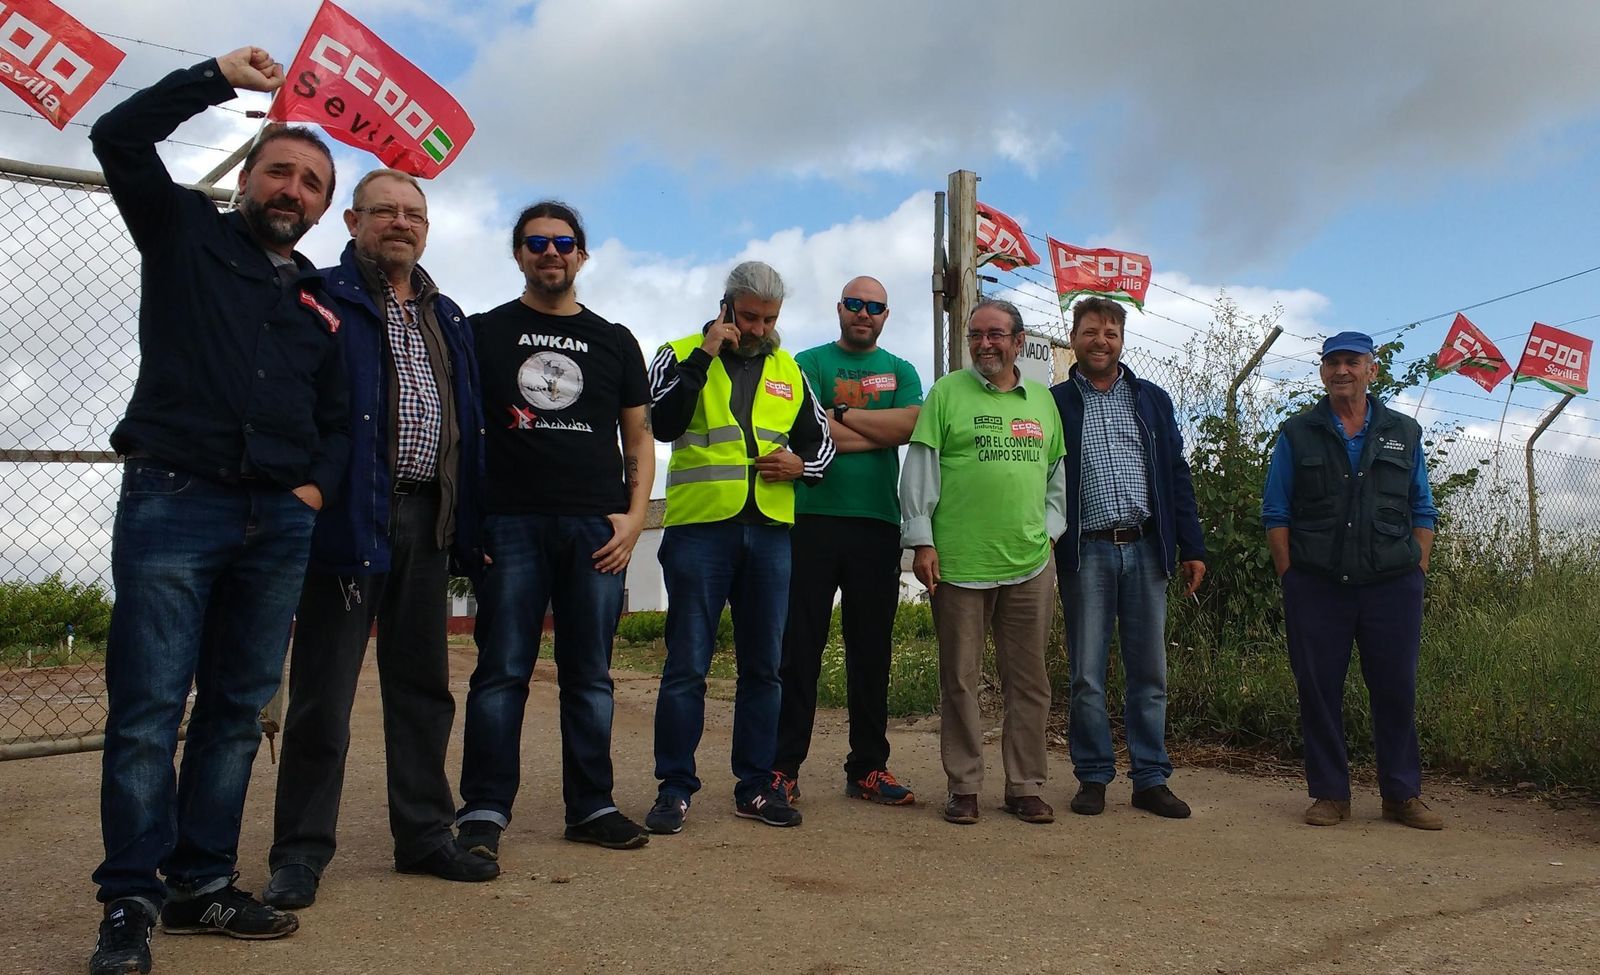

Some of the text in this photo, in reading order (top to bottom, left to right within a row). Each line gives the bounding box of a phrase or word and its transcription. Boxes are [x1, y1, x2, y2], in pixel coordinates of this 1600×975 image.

[0, 2, 94, 95] OO
[0, 56, 60, 112] evilla
[309, 34, 434, 141] CCOO
[518, 333, 588, 352] AWKAN
[1020, 341, 1049, 362] IVADO
[1526, 336, 1583, 369] CCOO
[1545, 363, 1580, 381] Sevilla
[975, 435, 992, 448] POR
[993, 436, 1003, 448] EL
[979, 449, 1010, 462] CAMPO
